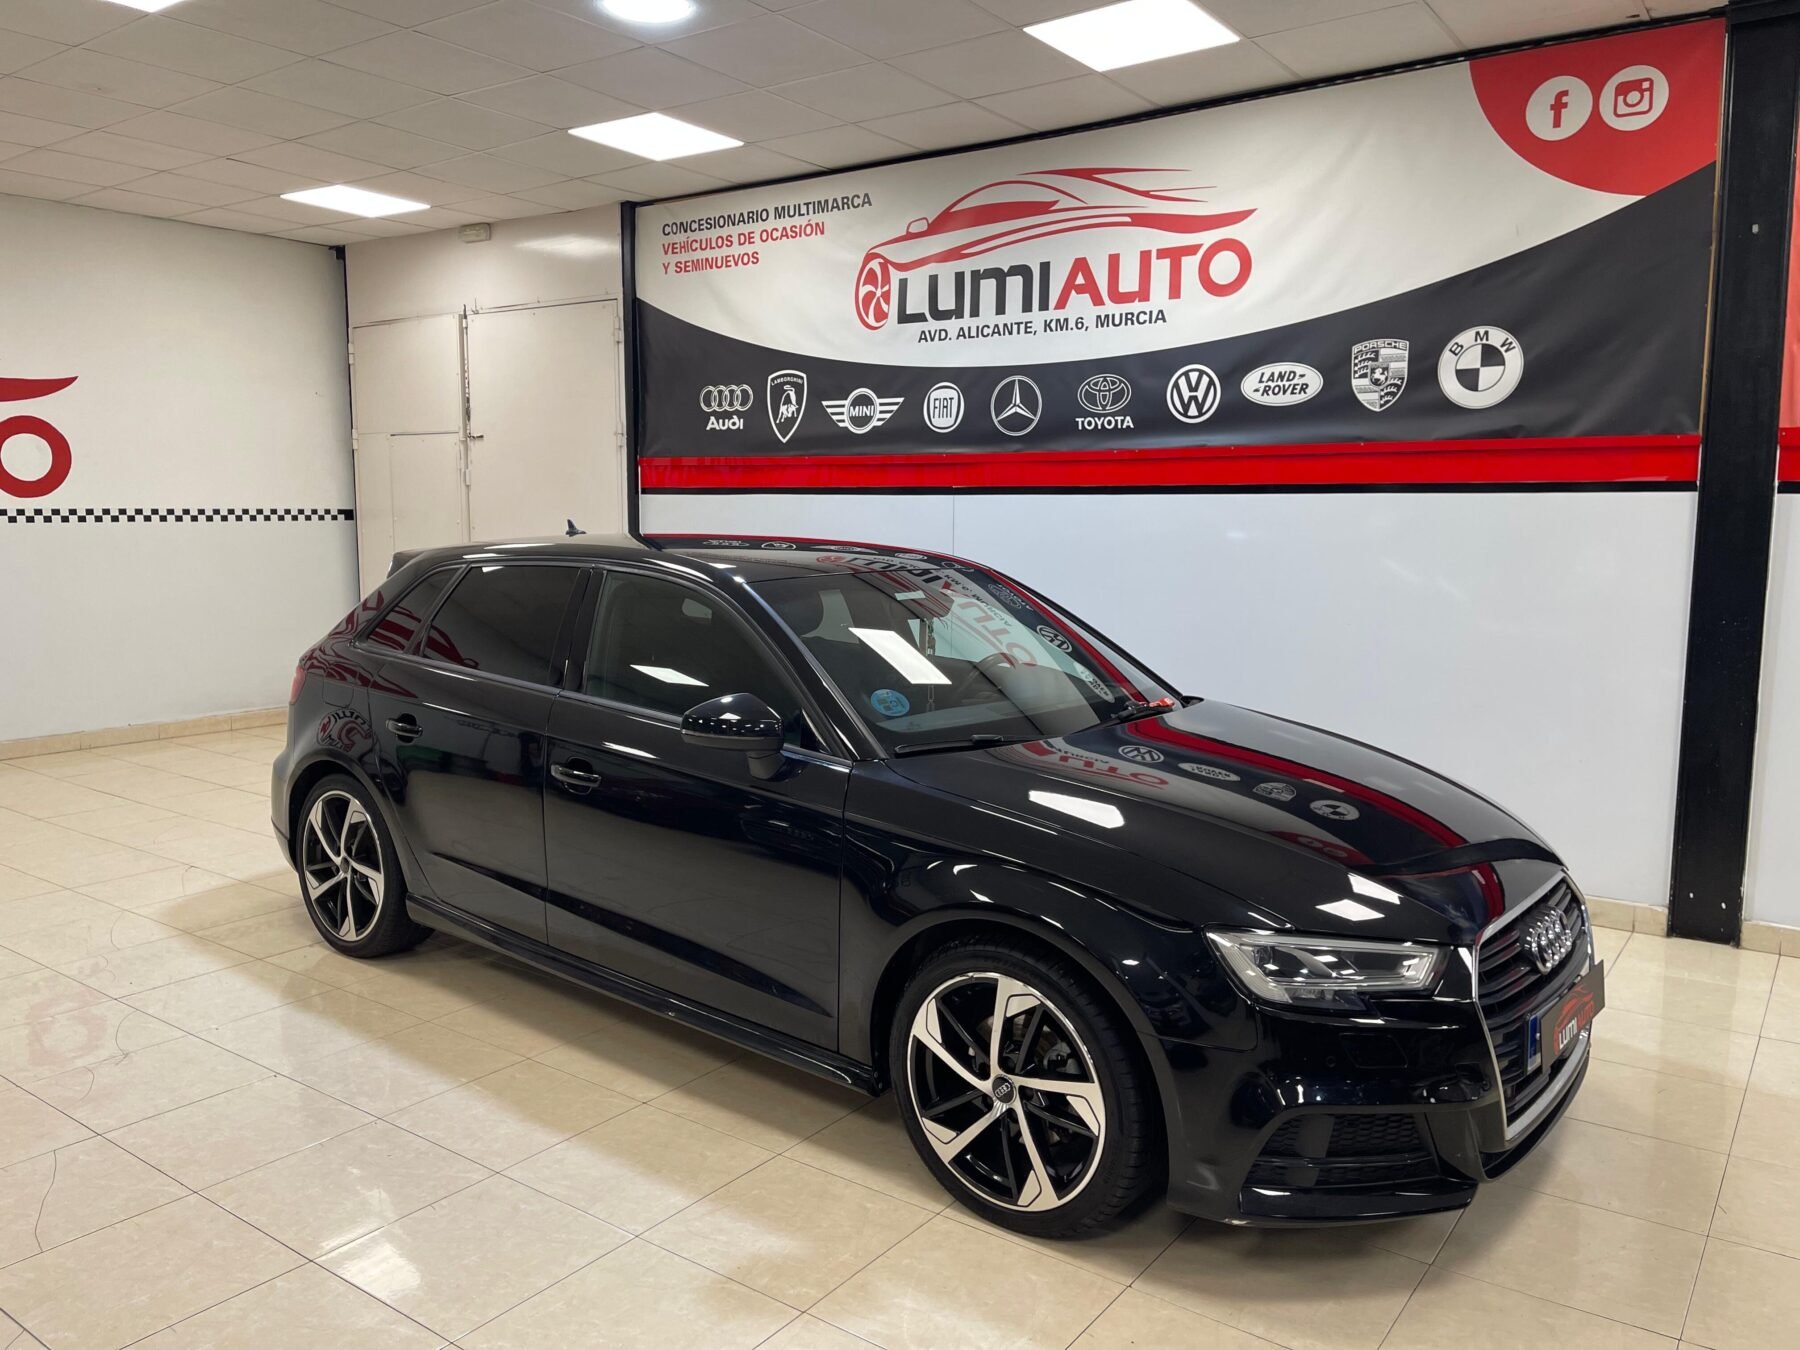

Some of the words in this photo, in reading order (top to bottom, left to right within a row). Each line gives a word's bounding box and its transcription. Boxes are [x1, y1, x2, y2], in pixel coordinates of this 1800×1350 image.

[662, 208, 770, 236] CONCESIONARIO
[774, 192, 873, 221] MULTIMARCA
[662, 234, 733, 256] VEHÍCULOS
[737, 231, 755, 246] DE
[759, 219, 825, 244] OCASIÓN
[662, 262, 670, 275] Y
[674, 251, 760, 274] SEMINUEVOS
[917, 327, 953, 344] AVD.
[956, 320, 1038, 340] ALICANTE,
[1043, 316, 1090, 334] KM.6,
[1095, 309, 1167, 330] MURCIA
[1354, 341, 1407, 354] PORSCHE
[850, 405, 875, 417] MINI
[932, 396, 955, 419] FIAT
[706, 415, 744, 430] Audi
[1075, 416, 1134, 430] TOYOTA
